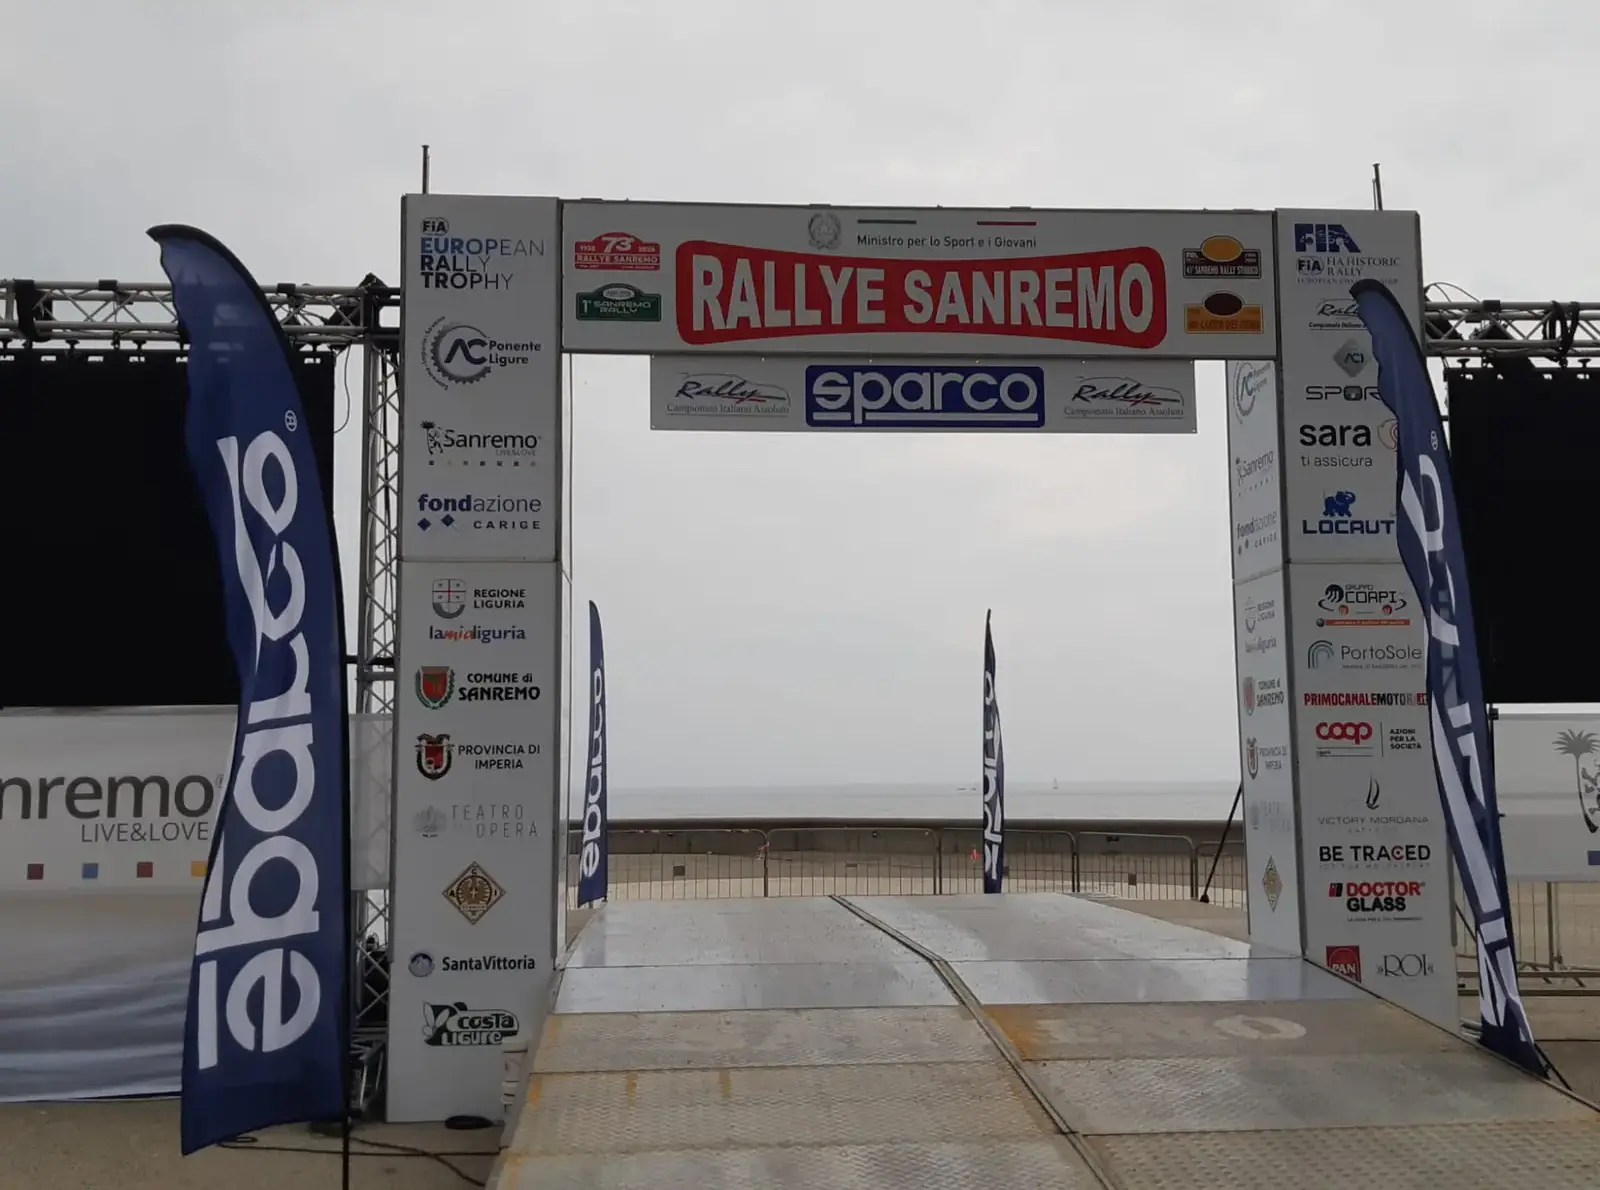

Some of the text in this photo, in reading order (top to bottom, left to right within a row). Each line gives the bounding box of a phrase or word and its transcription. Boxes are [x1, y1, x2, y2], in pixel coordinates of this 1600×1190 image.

[420, 237, 545, 256] EUROPEAN
[857, 234, 904, 246] Ministro
[907, 236, 925, 248] per
[930, 235, 941, 246] lo
[943, 236, 975, 248] Sport
[978, 238, 985, 247] e
[994, 236, 1037, 248] Giovani
[420, 255, 491, 272] RALLY
[577, 254, 659, 264] RALLYE SANREMO
[1347, 257, 1401, 267] HISTORIC
[1327, 267, 1362, 276] RALLY
[420, 272, 514, 290] TROPHY
[692, 254, 1153, 333] RALLYE SANREMO
[594, 301, 652, 309] SANREMO
[489, 340, 542, 352] Ponente
[489, 353, 529, 367] Ligure
[675, 380, 787, 404] Rally
[813, 370, 1038, 425] sparco
[1072, 383, 1180, 406] Rally
[1305, 385, 1382, 401] SPOR
[443, 429, 538, 448] Sanremo
[1299, 424, 1372, 447] sara
[1301, 455, 1373, 467] ti assicura
[417, 493, 542, 512] fondazione
[473, 520, 541, 530] CARIGE
[1302, 519, 1395, 534] LOCAUT
[474, 589, 526, 598] REGIONE
[474, 600, 525, 609] LIGURIA
[1341, 645, 1423, 660] PortoSole
[467, 672, 533, 683] COMUNE di
[459, 686, 541, 702] SANREMO
[1315, 721, 1373, 745] coop
[458, 744, 541, 756] PROVINCIA DI
[475, 758, 524, 770] IMPERIA
[451, 804, 524, 821] TEATRO
[1317, 816, 1429, 825] VICTORY MORGANA
[81, 822, 209, 843] LIVE&LOVE
[476, 820, 538, 838] OPERA
[1319, 844, 1431, 861] BE TRACED
[1346, 881, 1421, 897] DOCTOR
[1346, 897, 1407, 912] GLASS
[442, 954, 535, 971] SantaVittoria
[1332, 963, 1357, 974] PAN
